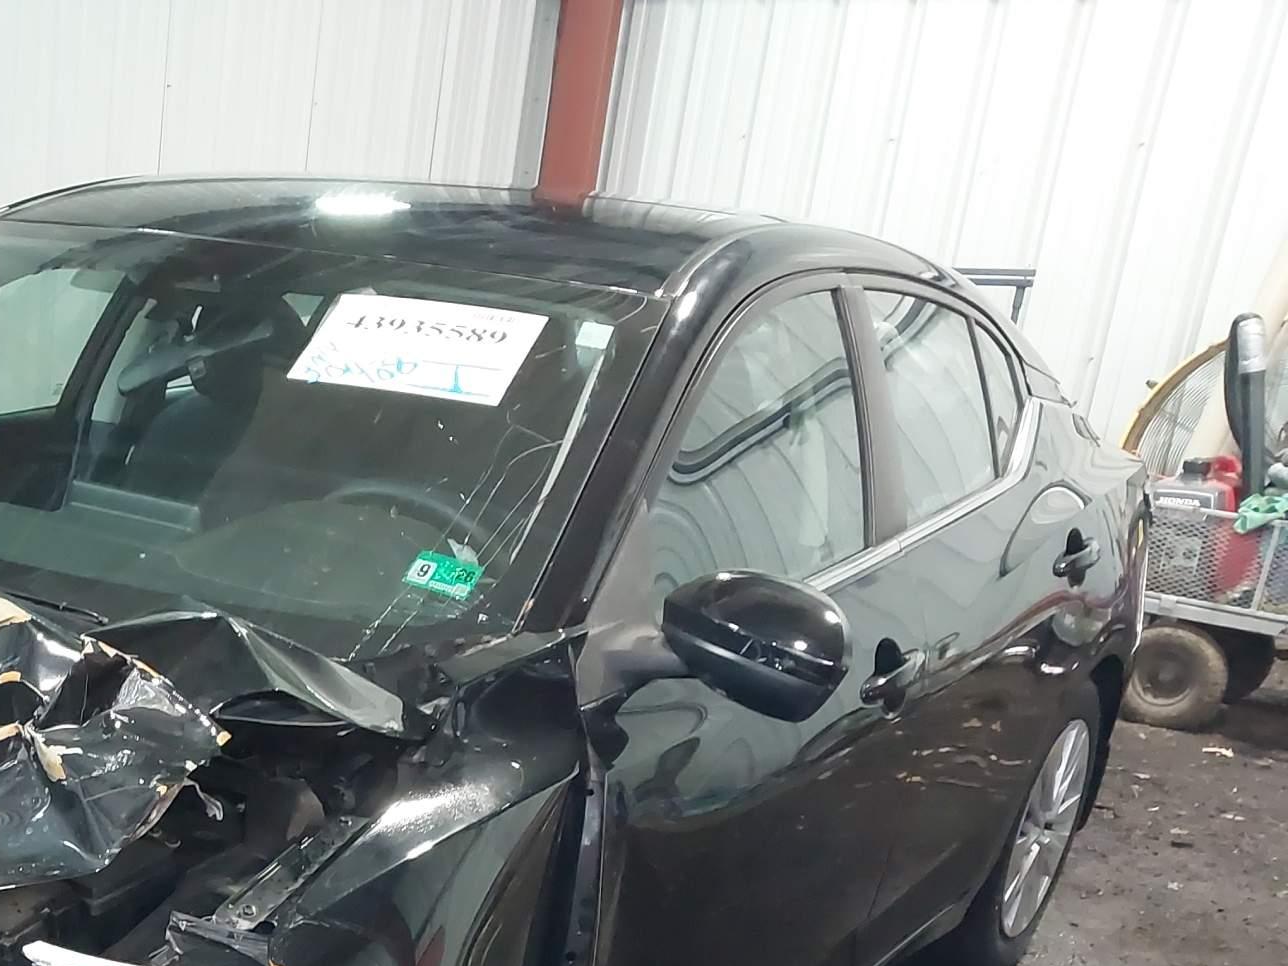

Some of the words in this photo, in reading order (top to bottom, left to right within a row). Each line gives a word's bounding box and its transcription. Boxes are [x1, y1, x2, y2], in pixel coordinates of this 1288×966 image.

[345, 313, 508, 345] 43935589
[1155, 496, 1201, 507] HONDA
[417, 564, 431, 577] 9
[455, 568, 475, 582] 26
